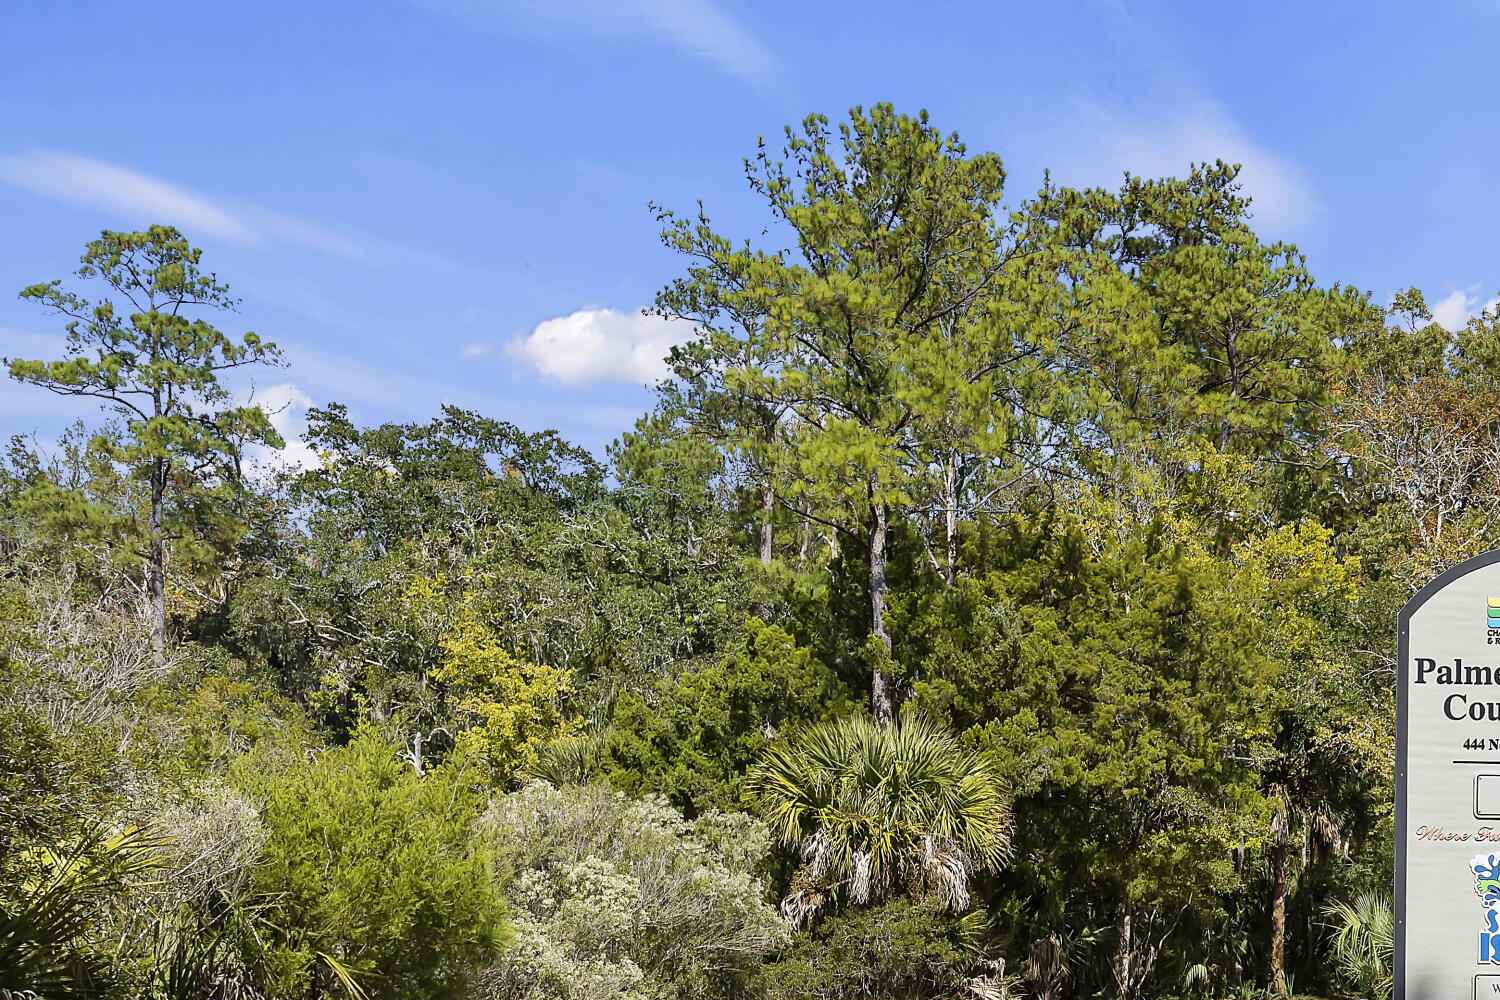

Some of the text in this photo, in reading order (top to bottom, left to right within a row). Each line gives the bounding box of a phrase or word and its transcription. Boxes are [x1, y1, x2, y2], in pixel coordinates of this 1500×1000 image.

[1487, 637, 1493, 645] &
[1463, 738, 1485, 751] 444
[1415, 825, 1471, 842] Where
